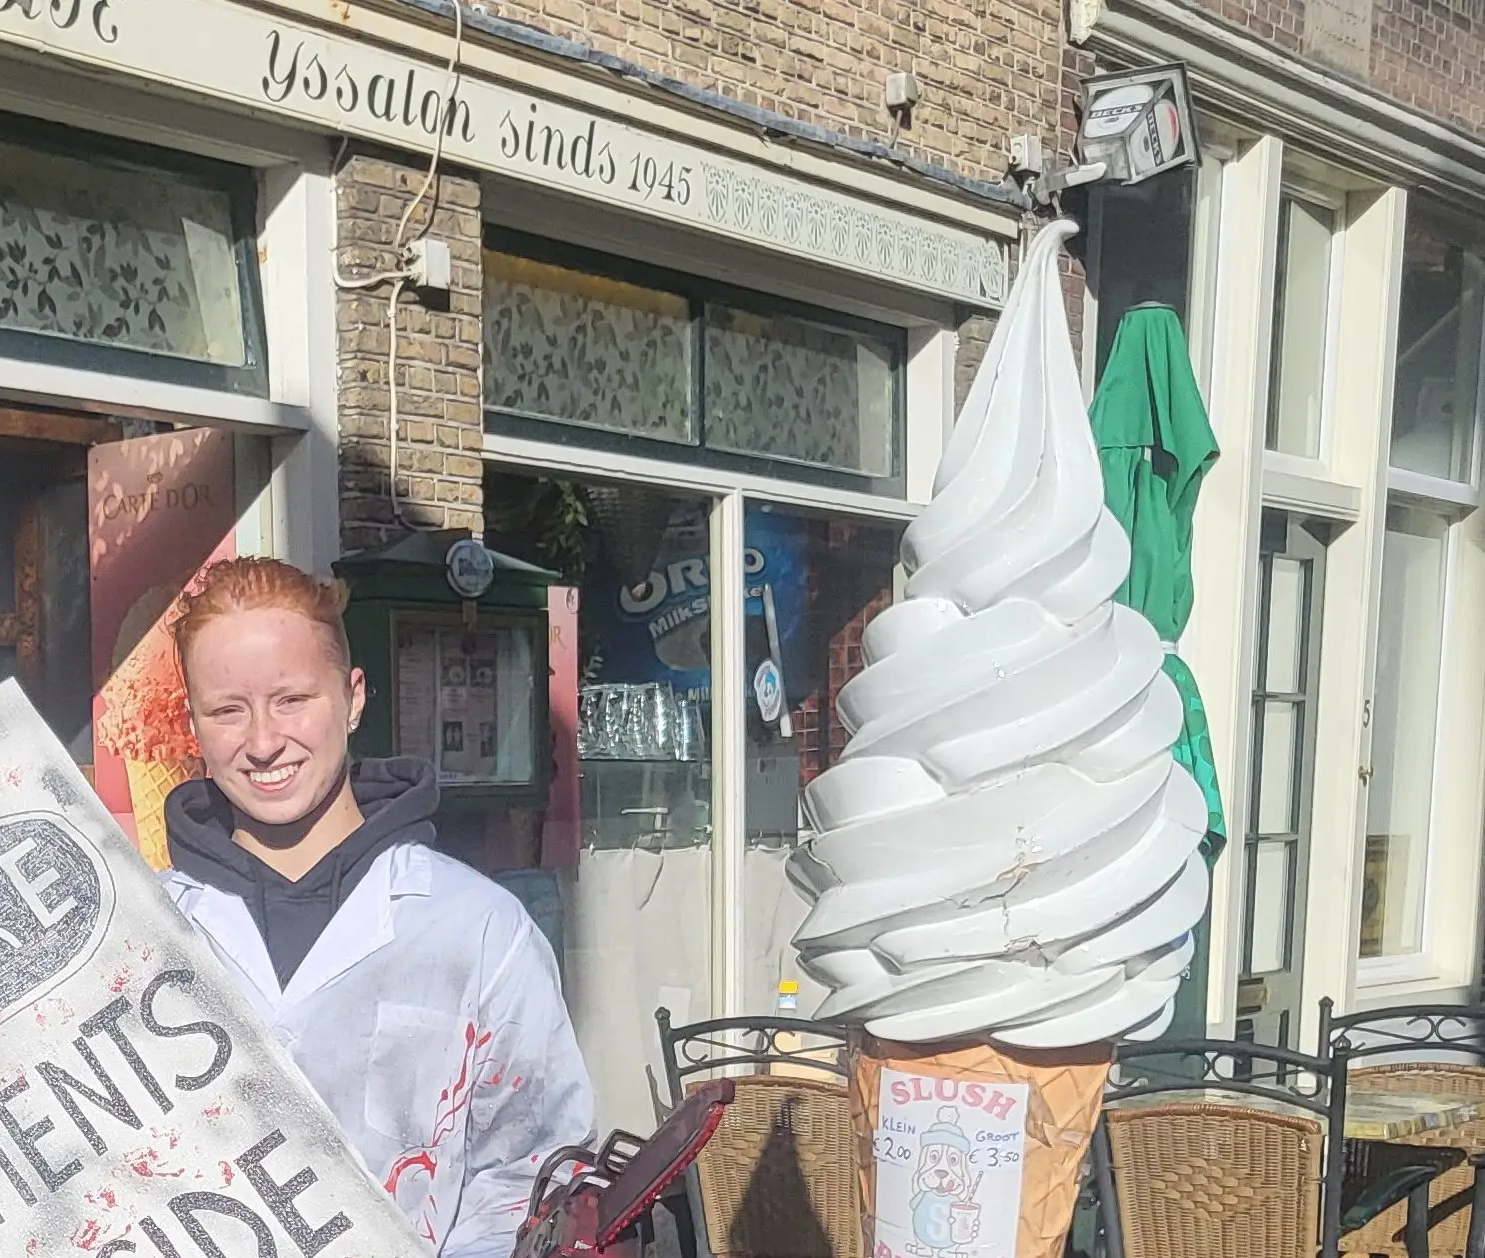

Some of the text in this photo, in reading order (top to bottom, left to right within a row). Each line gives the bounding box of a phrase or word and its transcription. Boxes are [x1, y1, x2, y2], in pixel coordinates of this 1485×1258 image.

[262, 30, 693, 206] Yssalon sinds 1945
[1363, 699, 1371, 728] 5
[890, 1077, 1017, 1121] SLUSH
[882, 1115, 917, 1135] KLEIN
